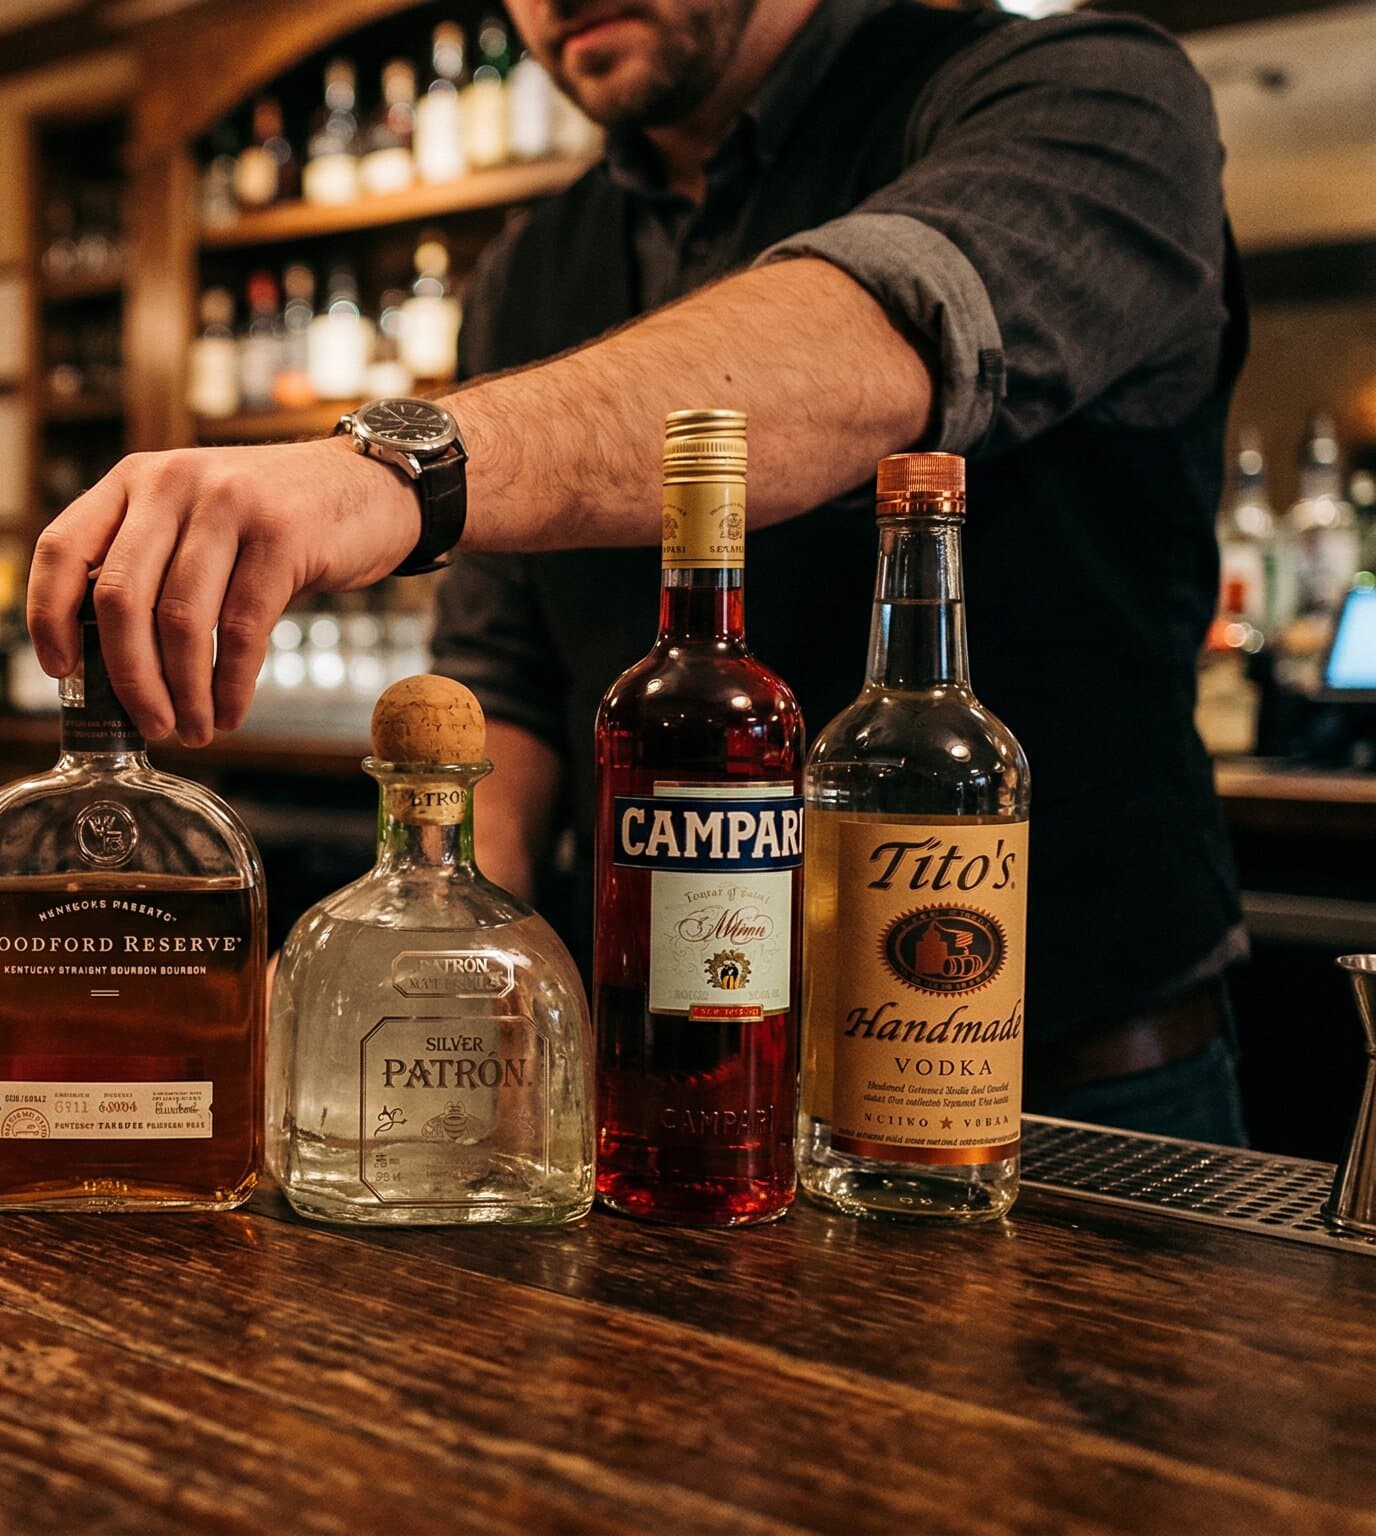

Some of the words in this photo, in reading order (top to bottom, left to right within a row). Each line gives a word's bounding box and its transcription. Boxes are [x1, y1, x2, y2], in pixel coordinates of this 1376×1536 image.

[620, 806, 804, 859] CAMPARI
[867, 837, 1016, 892] Tito's
[124, 934, 236, 952] RESERVE
[843, 998, 1022, 1044] Handmade
[425, 1034, 484, 1052] SILVER
[381, 1051, 530, 1091] PATRÓN
[894, 1056, 993, 1077] VODKA
